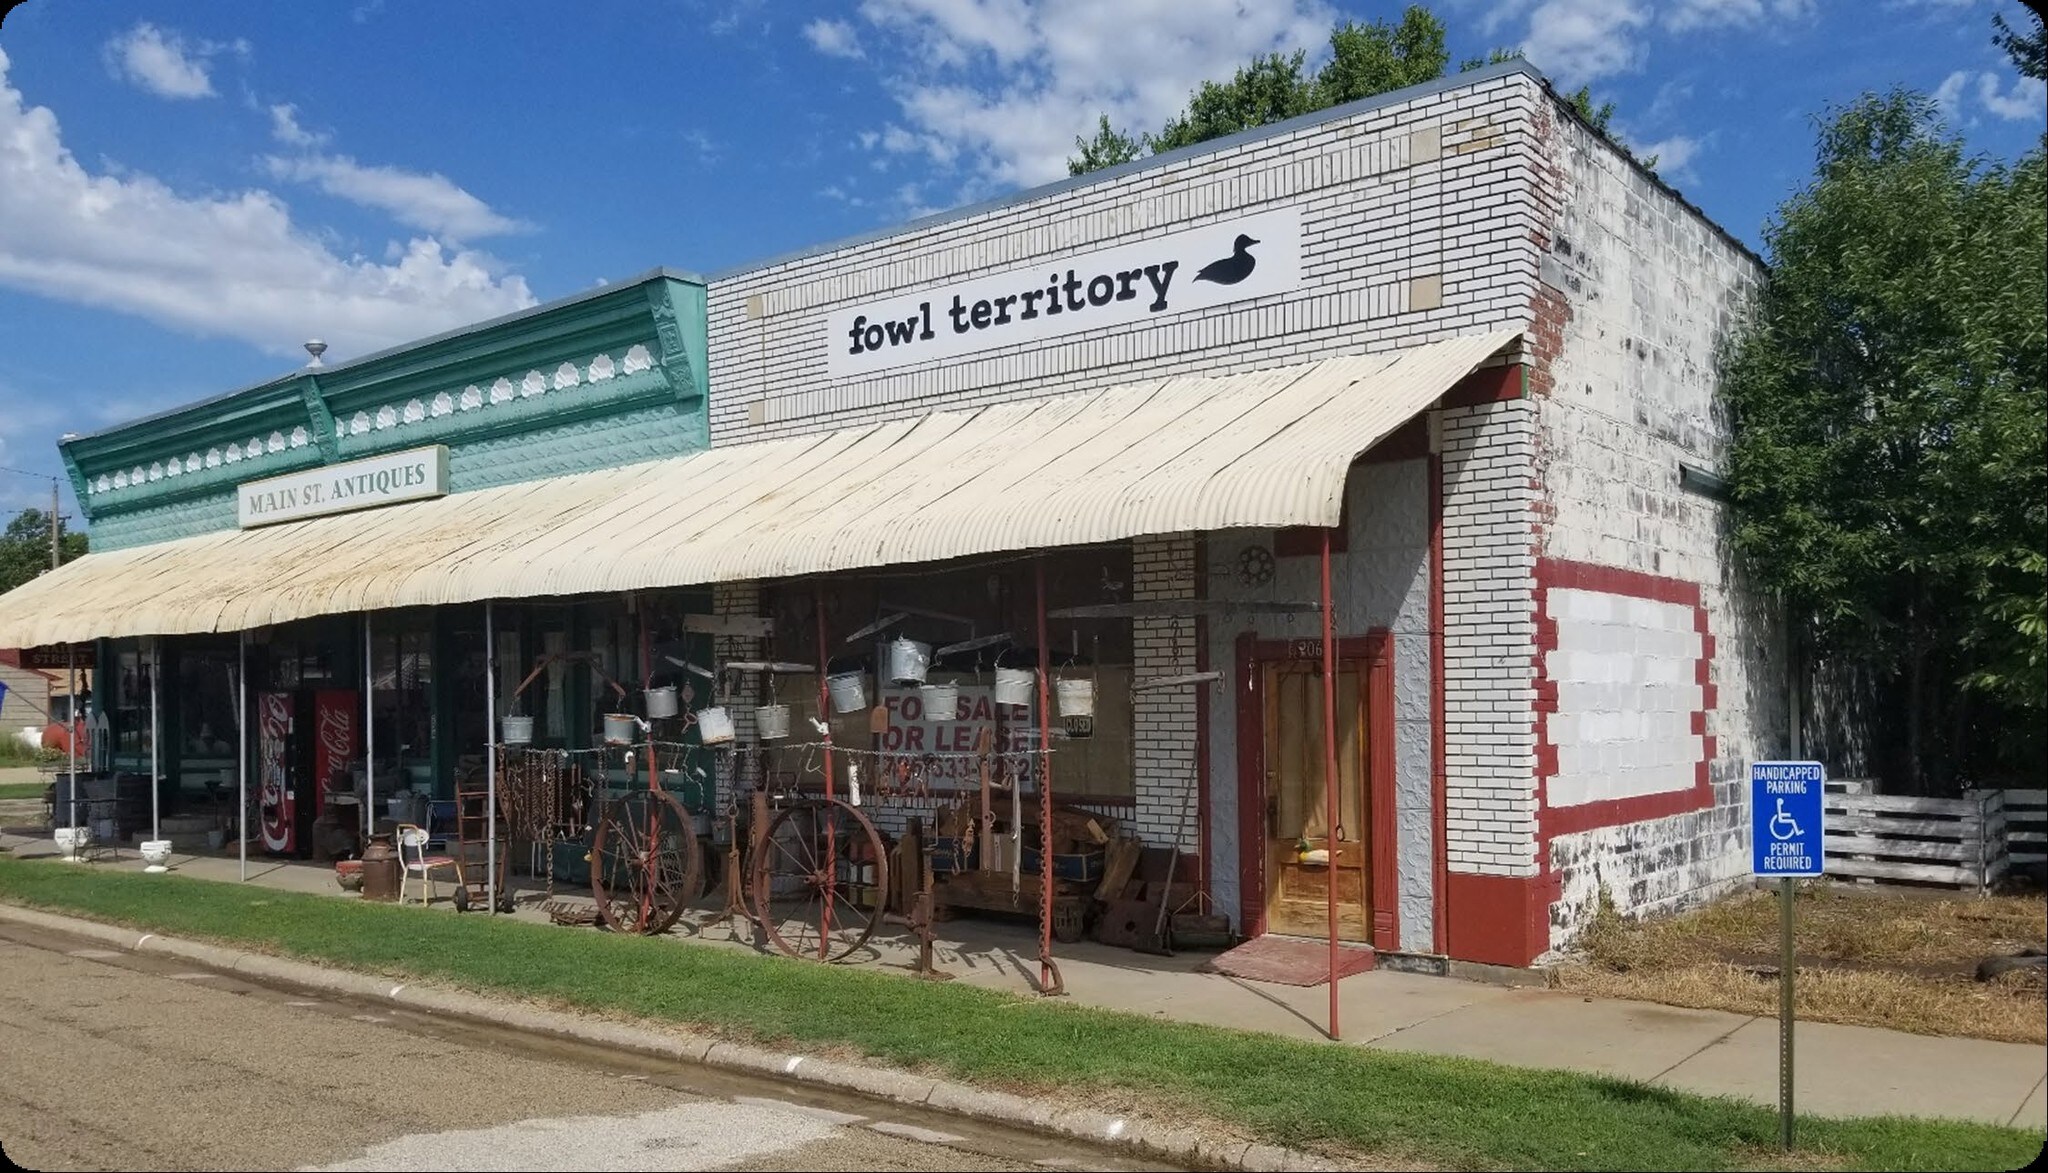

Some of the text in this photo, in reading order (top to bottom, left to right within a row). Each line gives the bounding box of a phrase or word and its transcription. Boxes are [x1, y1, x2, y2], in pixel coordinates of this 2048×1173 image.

[848, 260, 1179, 355] fowl territory
[249, 463, 426, 514] MAIN ST. ANTIQUES
[33, 653, 87, 664] STRET
[883, 695, 1030, 721] FO SALE
[882, 726, 924, 751] OR
[320, 704, 351, 793] a-Cola
[1753, 766, 1820, 780] HANDICAPPED
[1766, 780, 1807, 794] PARKING
[1770, 842, 1805, 856] PERMIT
[1764, 856, 1812, 870] REQUIRED
